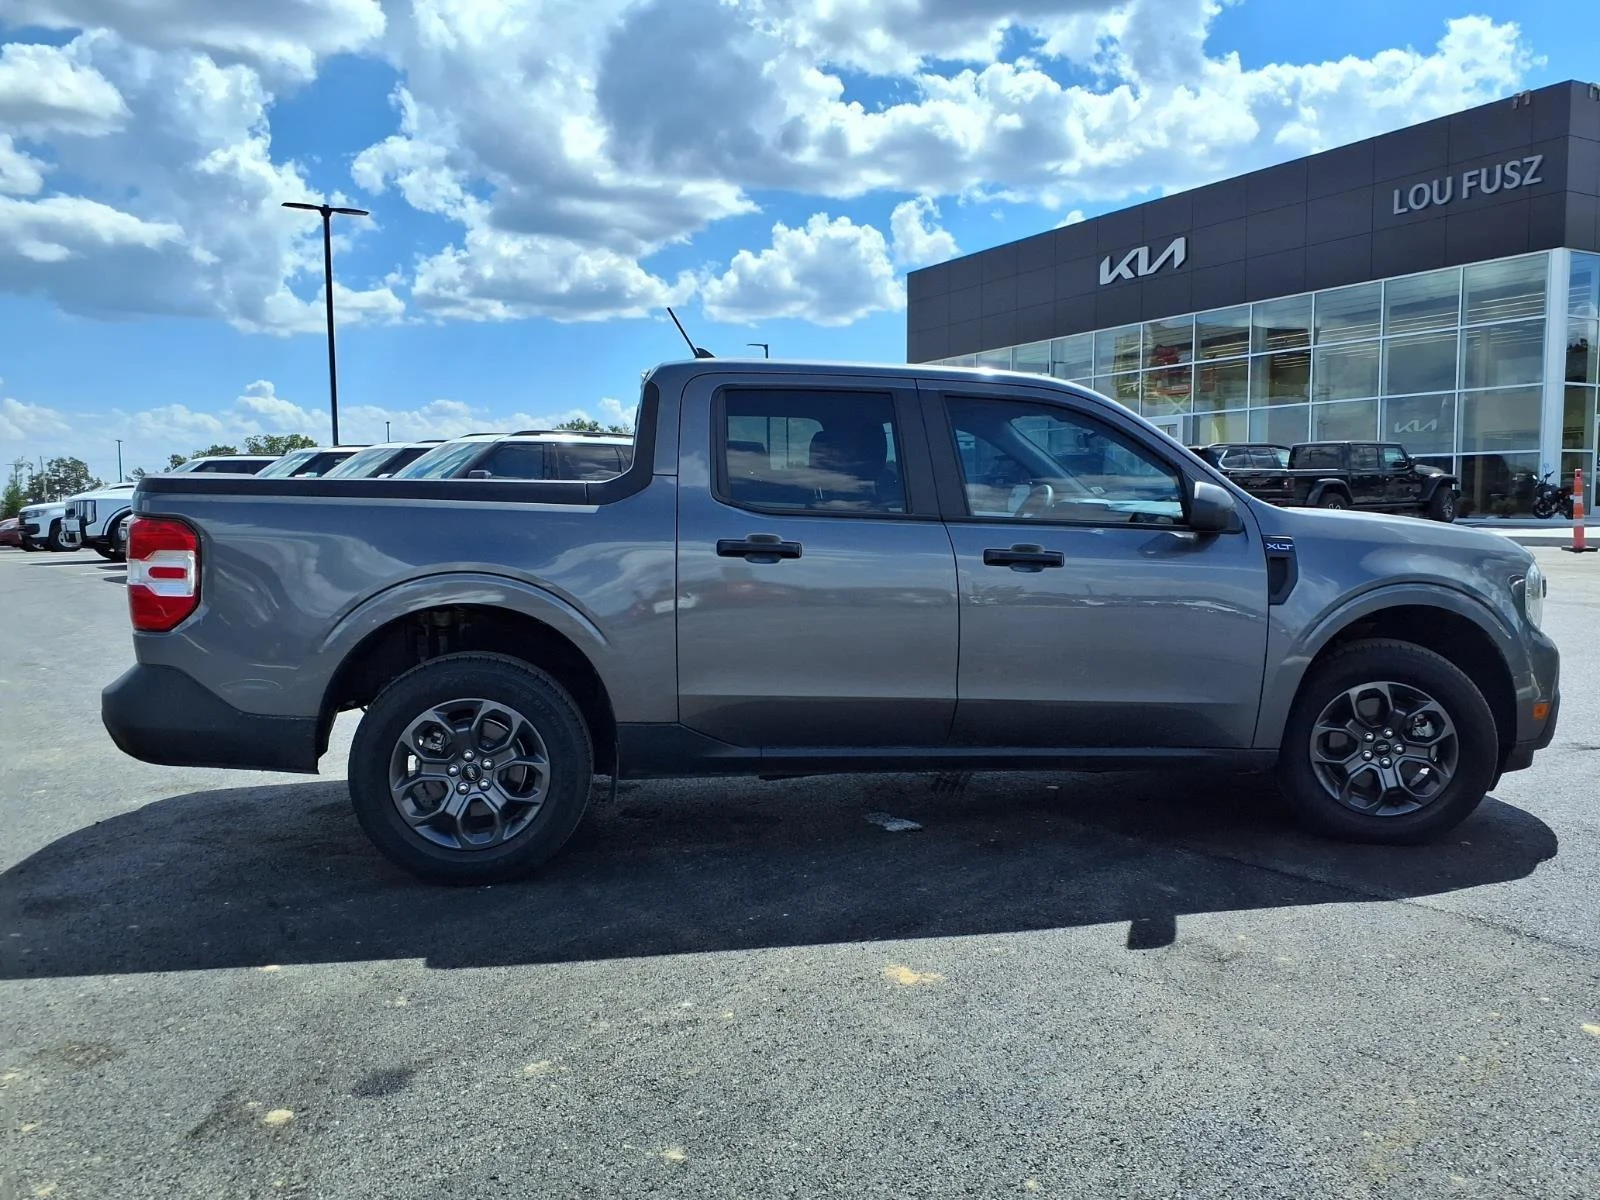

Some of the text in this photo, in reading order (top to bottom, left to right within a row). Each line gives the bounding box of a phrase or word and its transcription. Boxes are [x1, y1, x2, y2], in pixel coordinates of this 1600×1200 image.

[1393, 154, 1544, 215] LOU FUSZ
[1099, 236, 1187, 286] KIA
[1394, 418, 1438, 433] KIA
